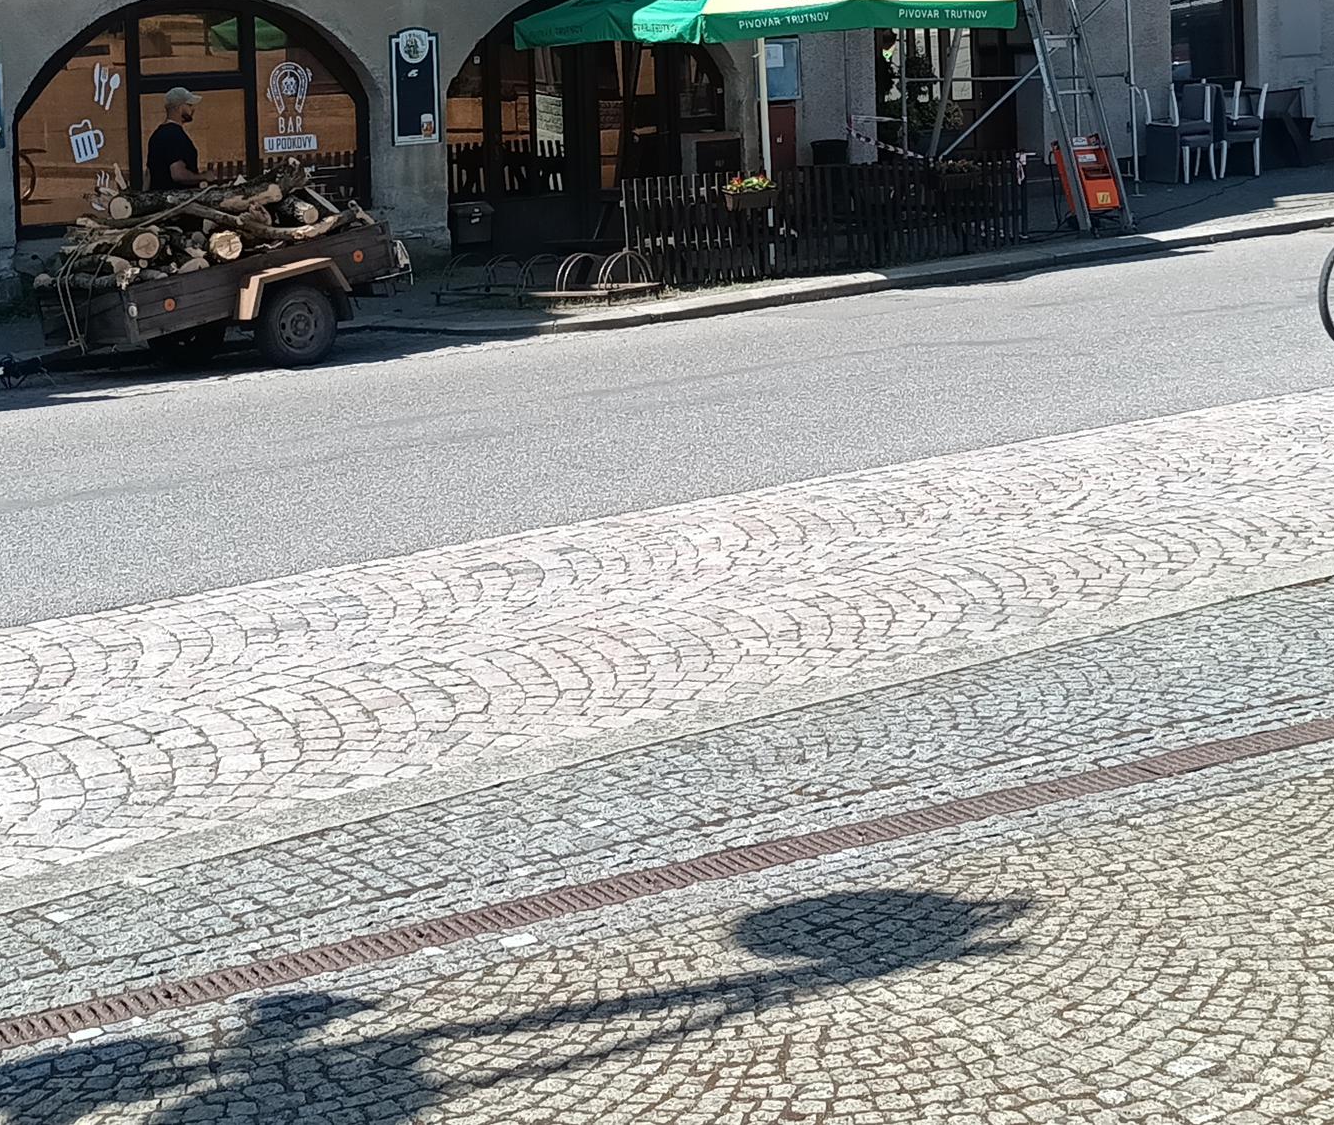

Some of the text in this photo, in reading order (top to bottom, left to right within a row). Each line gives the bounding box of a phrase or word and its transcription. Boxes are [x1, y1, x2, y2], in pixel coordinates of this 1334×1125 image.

[738, 11, 830, 29] PIVOVAR TRUTNOV
[898, 8, 988, 20] PIVOVAR TRUTNOV
[278, 116, 302, 134] BAR
[268, 136, 312, 150] U PODKOVY
